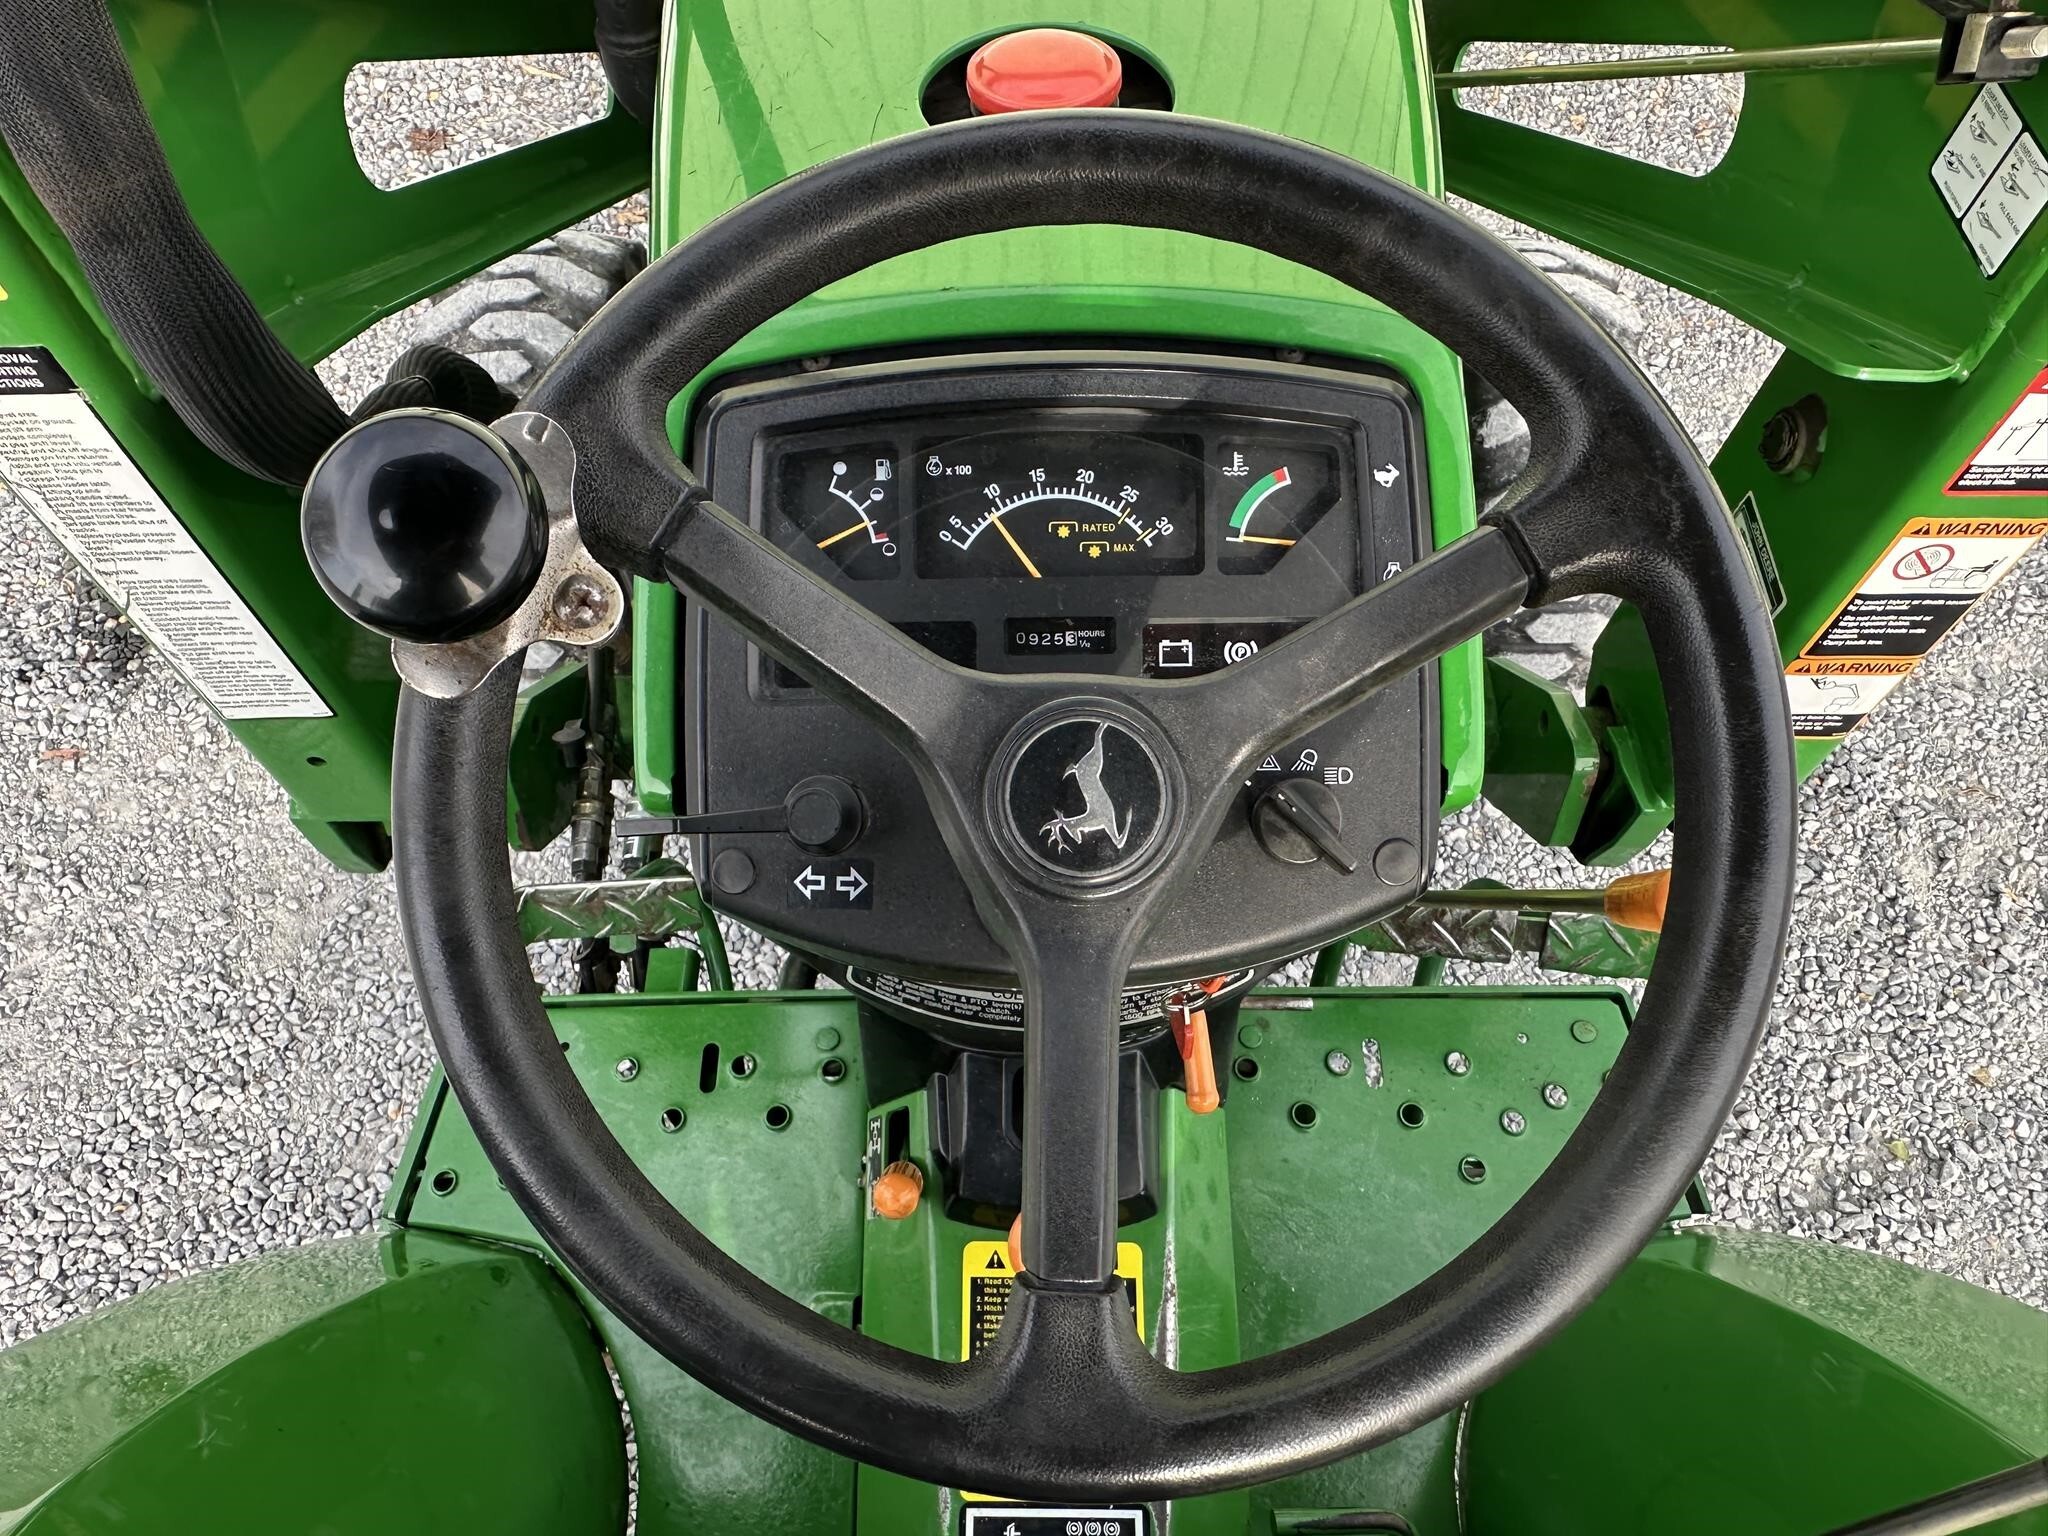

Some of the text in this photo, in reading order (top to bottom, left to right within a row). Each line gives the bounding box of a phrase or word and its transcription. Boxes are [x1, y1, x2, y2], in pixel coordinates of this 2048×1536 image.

[0, 353, 38, 364] OVAL
[945, 464, 972, 476] x 100
[1029, 468, 1046, 482] 15
[1076, 468, 1094, 484] 20
[983, 482, 1001, 501] 10
[1119, 485, 1140, 503] 25
[949, 515, 962, 529] 5
[1082, 523, 1116, 532] RATED
[1155, 516, 1174, 537] 30
[1935, 522, 2047, 536] WARNING
[938, 530, 951, 542] 0
[1078, 630, 1105, 638] HOURS
[1815, 662, 1913, 674] WARNING
[970, 998, 988, 1006] PTO
[984, 1296, 1002, 1304] Keep
